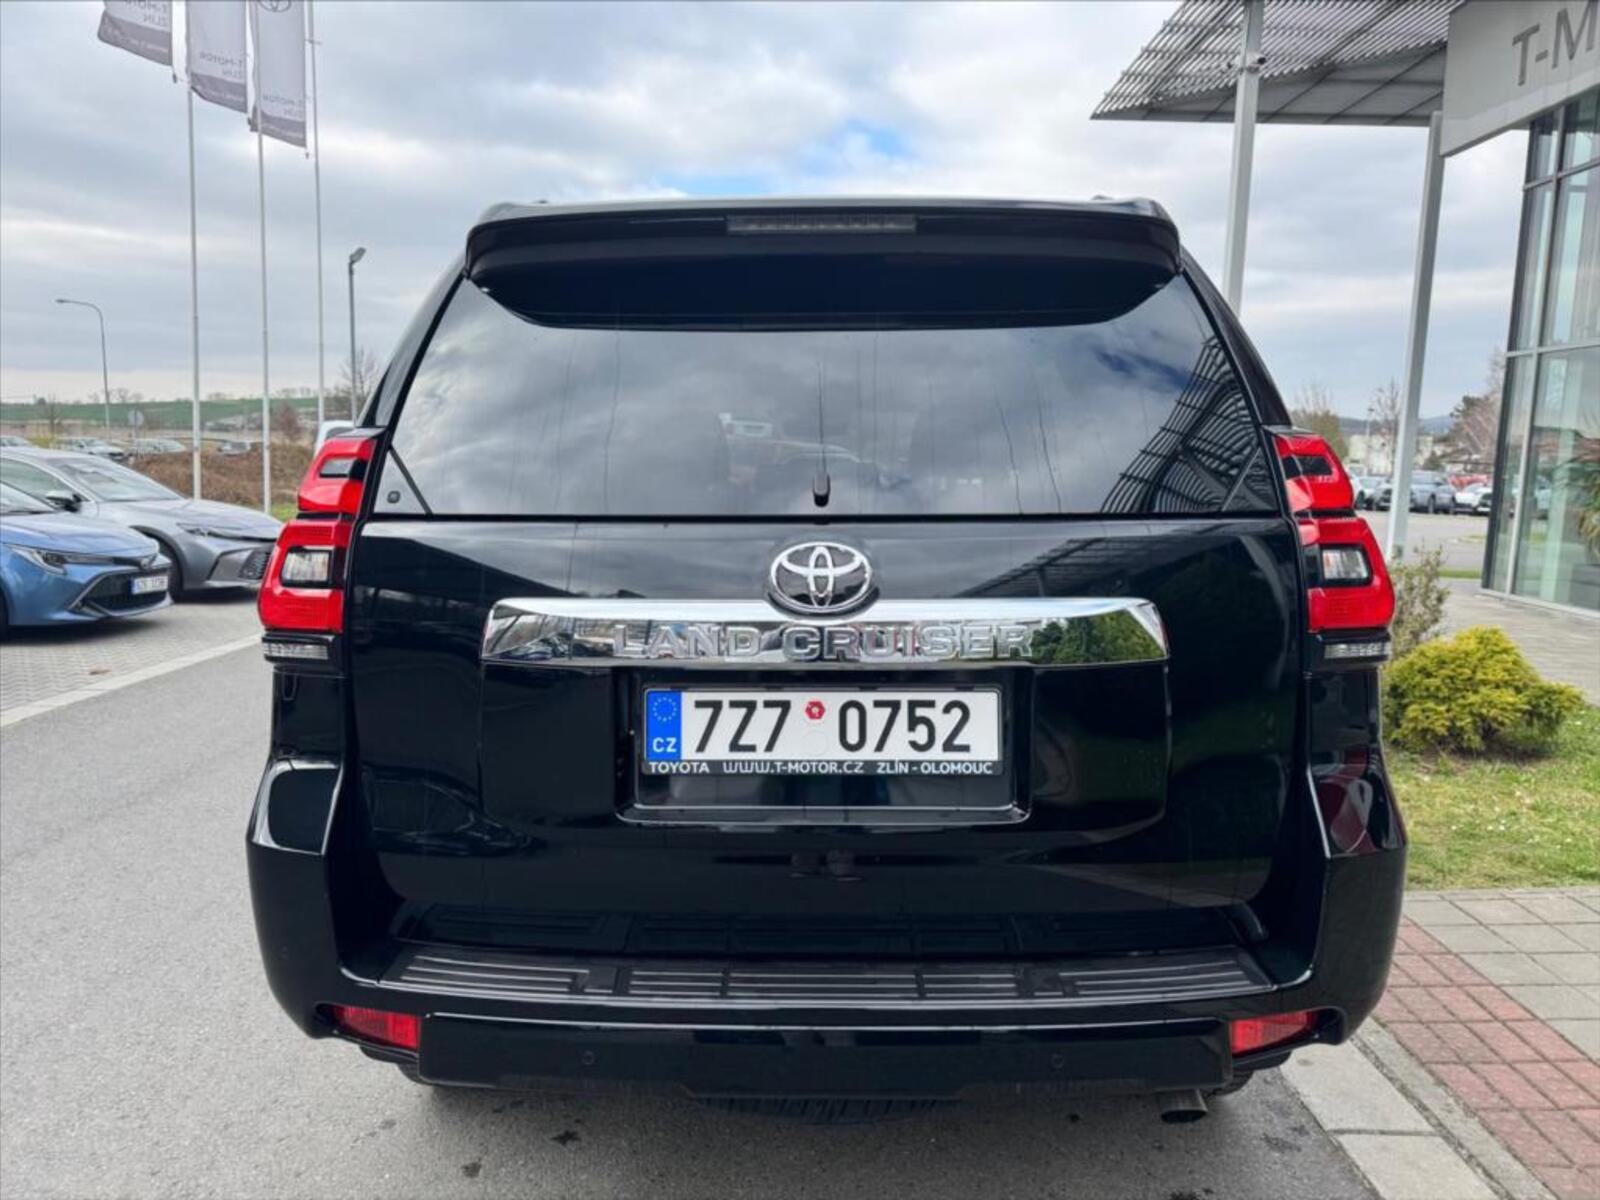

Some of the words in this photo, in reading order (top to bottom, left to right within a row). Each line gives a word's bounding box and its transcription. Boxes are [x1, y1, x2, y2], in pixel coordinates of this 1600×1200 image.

[613, 623, 761, 659] LAND
[781, 624, 1034, 660] CRUISER
[694, 700, 791, 752] 7Z7
[839, 700, 970, 752] 0752
[652, 737, 677, 752] CZ
[649, 761, 710, 774] TOYOTA
[723, 761, 864, 774] WWW.T-MOTOR.CZ
[876, 758, 909, 774] ZLÍN
[920, 761, 993, 774] OLOMOUC
